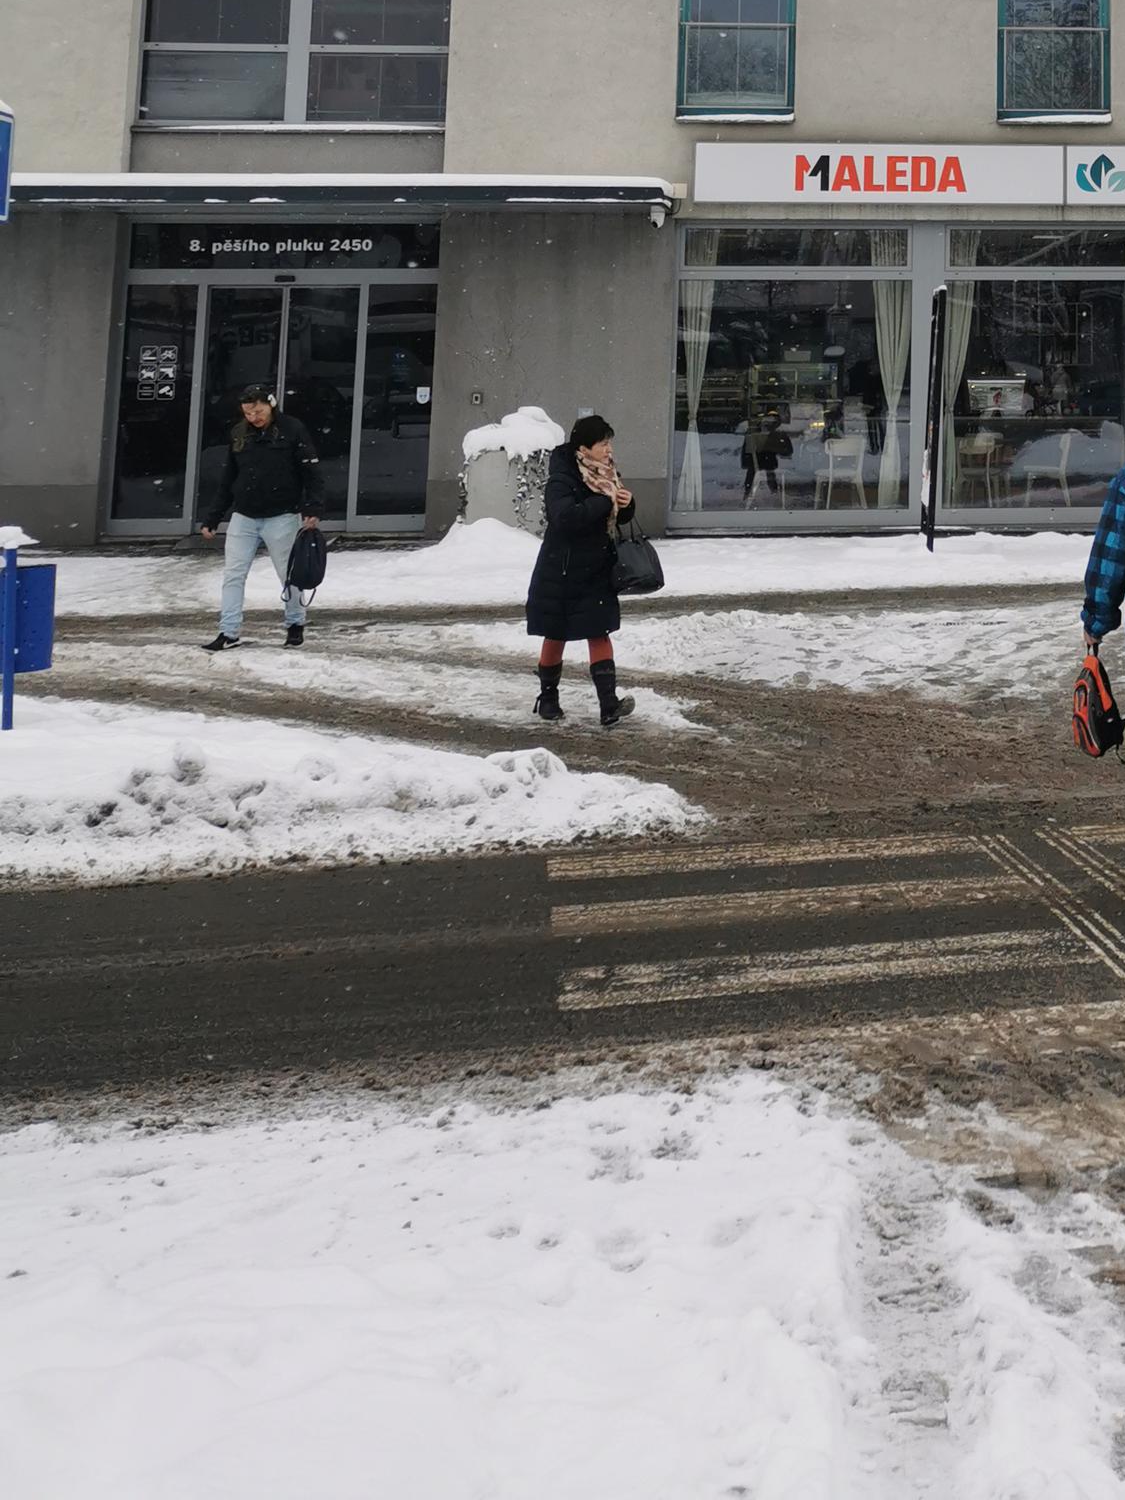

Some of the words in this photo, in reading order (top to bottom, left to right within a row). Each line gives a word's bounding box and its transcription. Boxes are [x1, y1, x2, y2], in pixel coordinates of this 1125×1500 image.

[795, 154, 967, 193] MALEDA
[189, 239, 206, 252] 8.
[212, 239, 270, 255] pěšího
[275, 239, 324, 255] pluku
[330, 239, 373, 252] 2450
